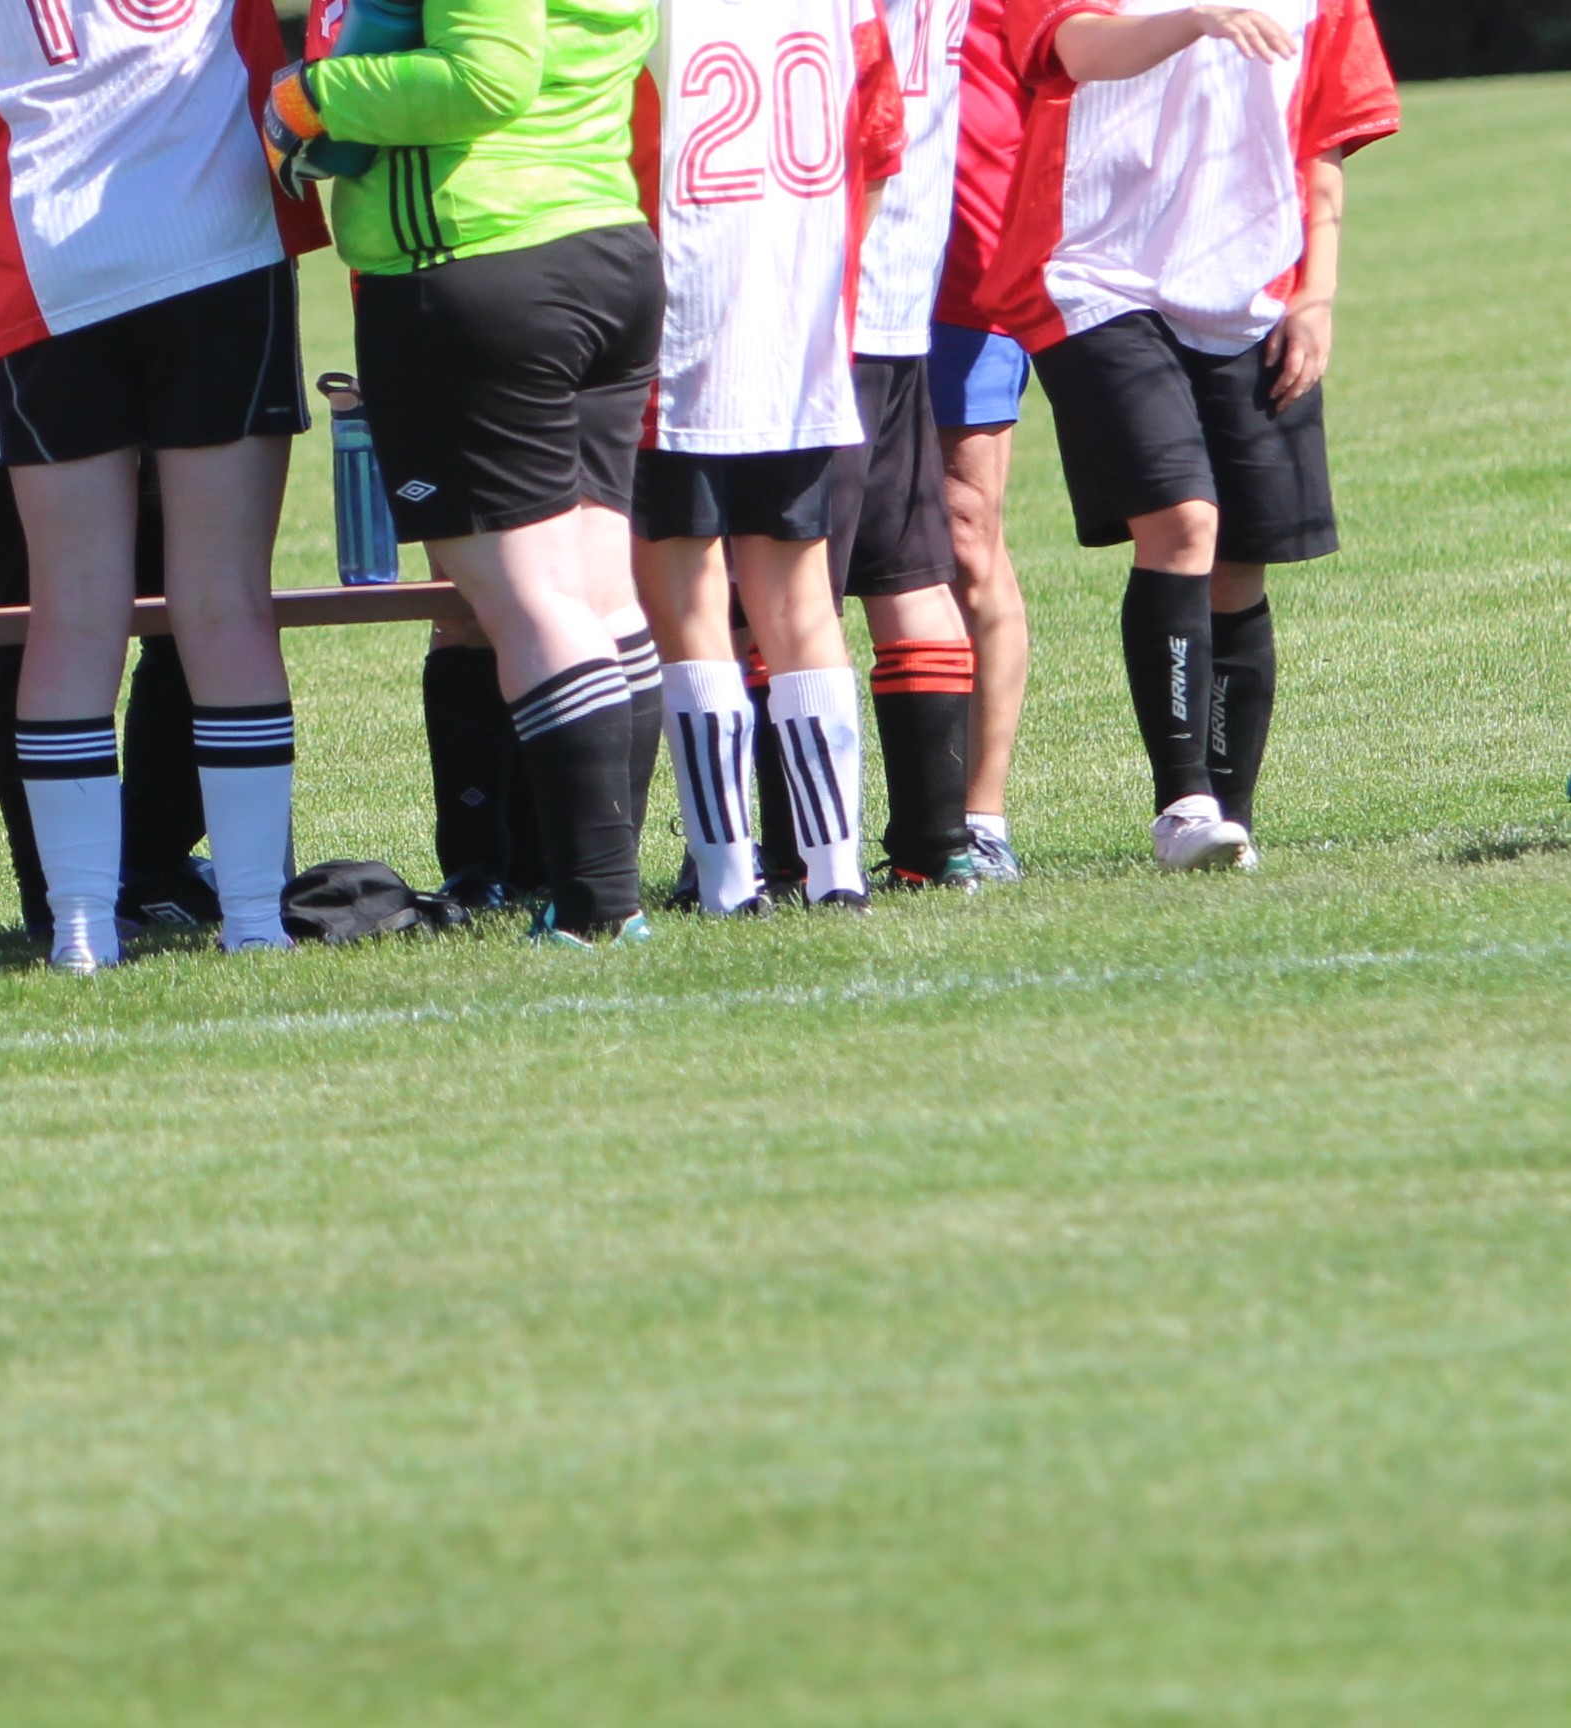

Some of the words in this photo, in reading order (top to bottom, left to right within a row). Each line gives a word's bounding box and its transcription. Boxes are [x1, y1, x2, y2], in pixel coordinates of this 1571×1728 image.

[676, 31, 845, 206] 20
[1168, 635, 1188, 722] BRINE
[1211, 674, 1229, 756] BRINE
